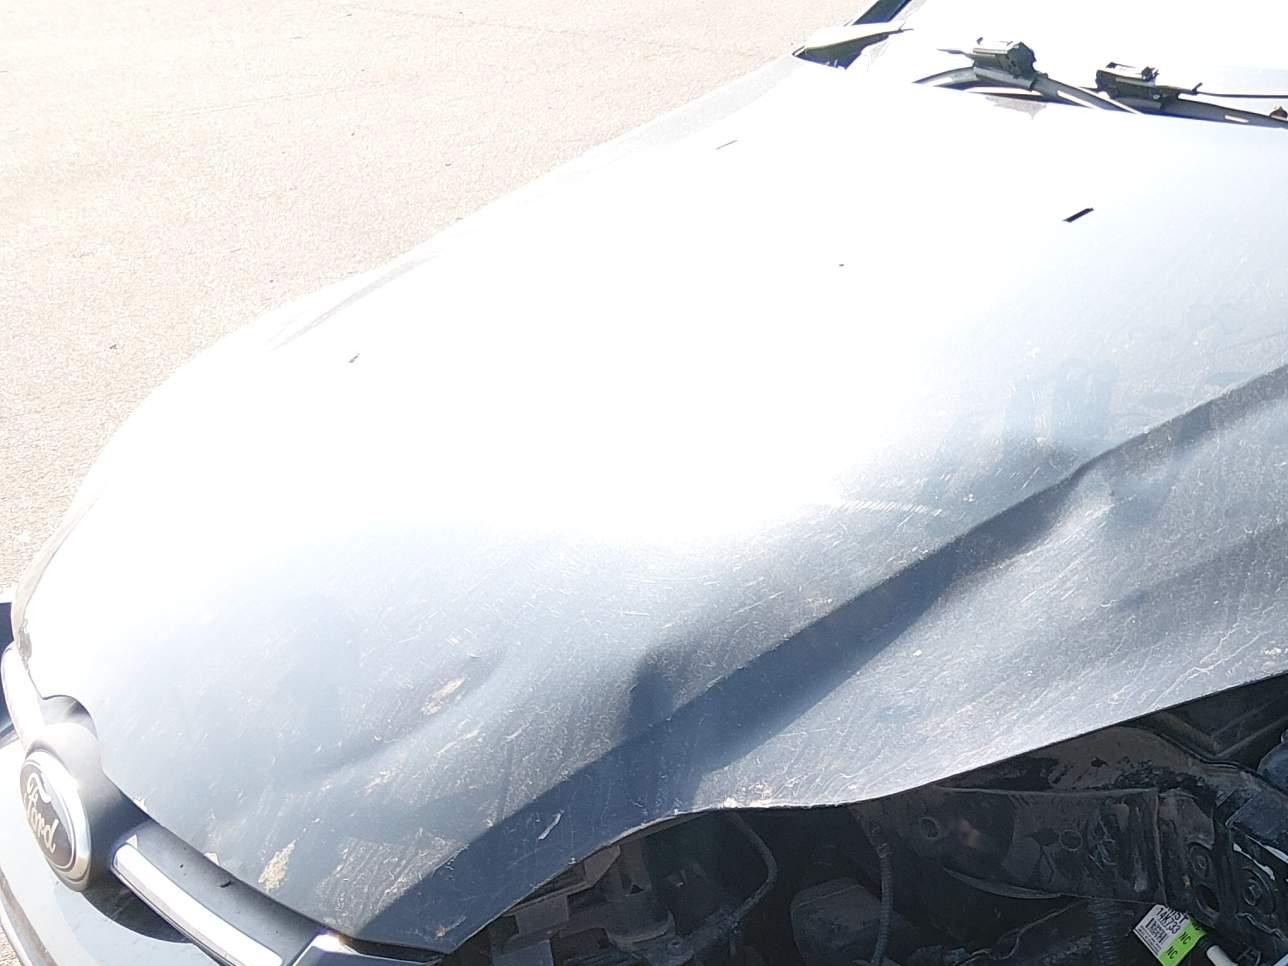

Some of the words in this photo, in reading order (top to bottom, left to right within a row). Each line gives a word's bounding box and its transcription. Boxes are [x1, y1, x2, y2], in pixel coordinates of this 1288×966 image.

[24, 772, 59, 854] Ford
[1157, 907, 1181, 934] 14K733
[1179, 931, 1192, 945] NC
[1165, 945, 1179, 960] NC
